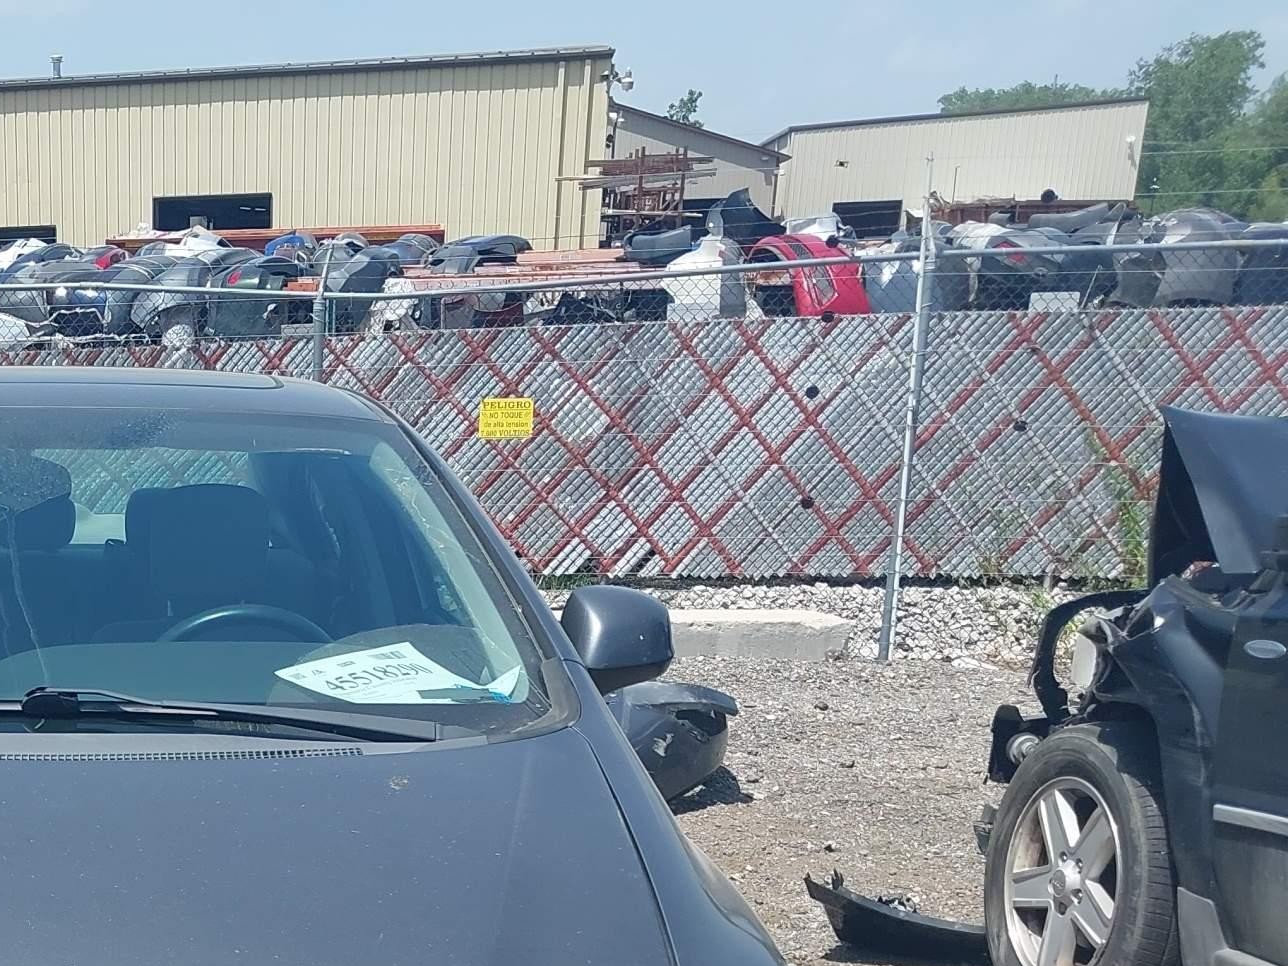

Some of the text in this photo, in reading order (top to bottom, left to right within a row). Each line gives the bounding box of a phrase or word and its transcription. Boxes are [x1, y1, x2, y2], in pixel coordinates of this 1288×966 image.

[483, 401, 531, 409] PELIGRO
[501, 411, 522, 419] TOQUE
[325, 663, 433, 691] 45518290
